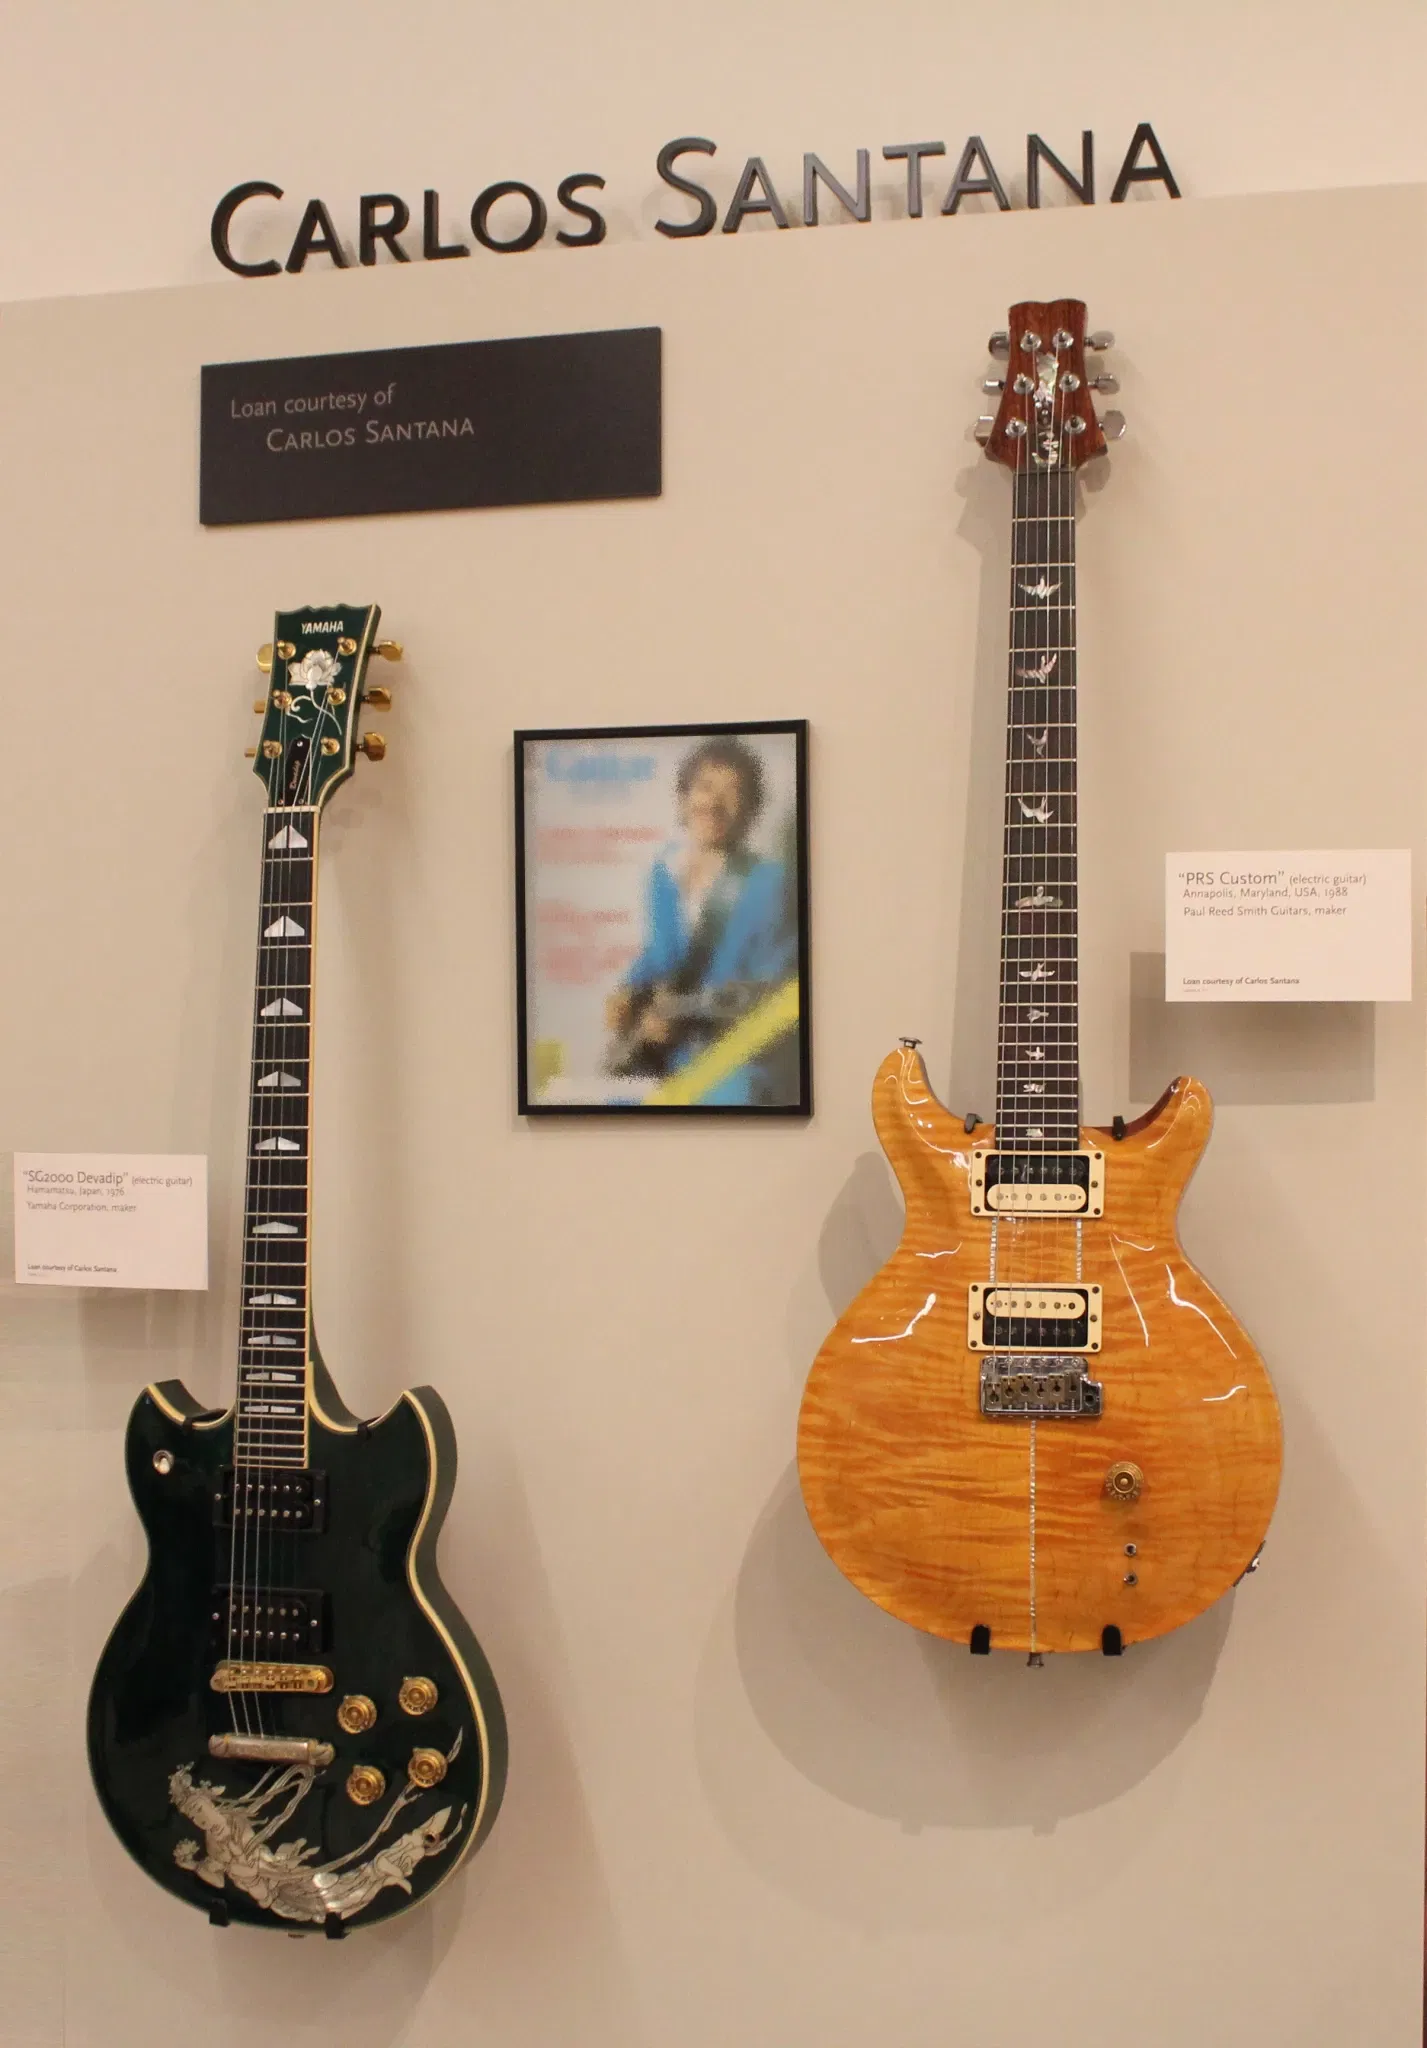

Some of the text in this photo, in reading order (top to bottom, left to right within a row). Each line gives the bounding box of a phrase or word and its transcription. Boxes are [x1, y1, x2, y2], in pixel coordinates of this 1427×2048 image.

[210, 122, 1182, 279] CARLOS SANTANA
[231, 382, 397, 419] Loan courtesy of
[266, 417, 475, 452] CARLOS SANTANA
[301, 620, 344, 635] YAMAHA
[1289, 874, 1331, 886] (electric
[1333, 874, 1367, 887] guitar)
[1182, 886, 1349, 900] Annapolis, Maryland, USA, 1988
[1183, 905, 1347, 917] Paul Reed Smith Guitars, maker
[1183, 977, 1301, 988] Loan courtesy of Carlos Santana
[131, 1176, 164, 1186] (electric
[165, 1176, 193, 1187] guitar)
[106, 1187, 125, 1197] 1976
[27, 1201, 137, 1213] Yamaha Corporation, maker
